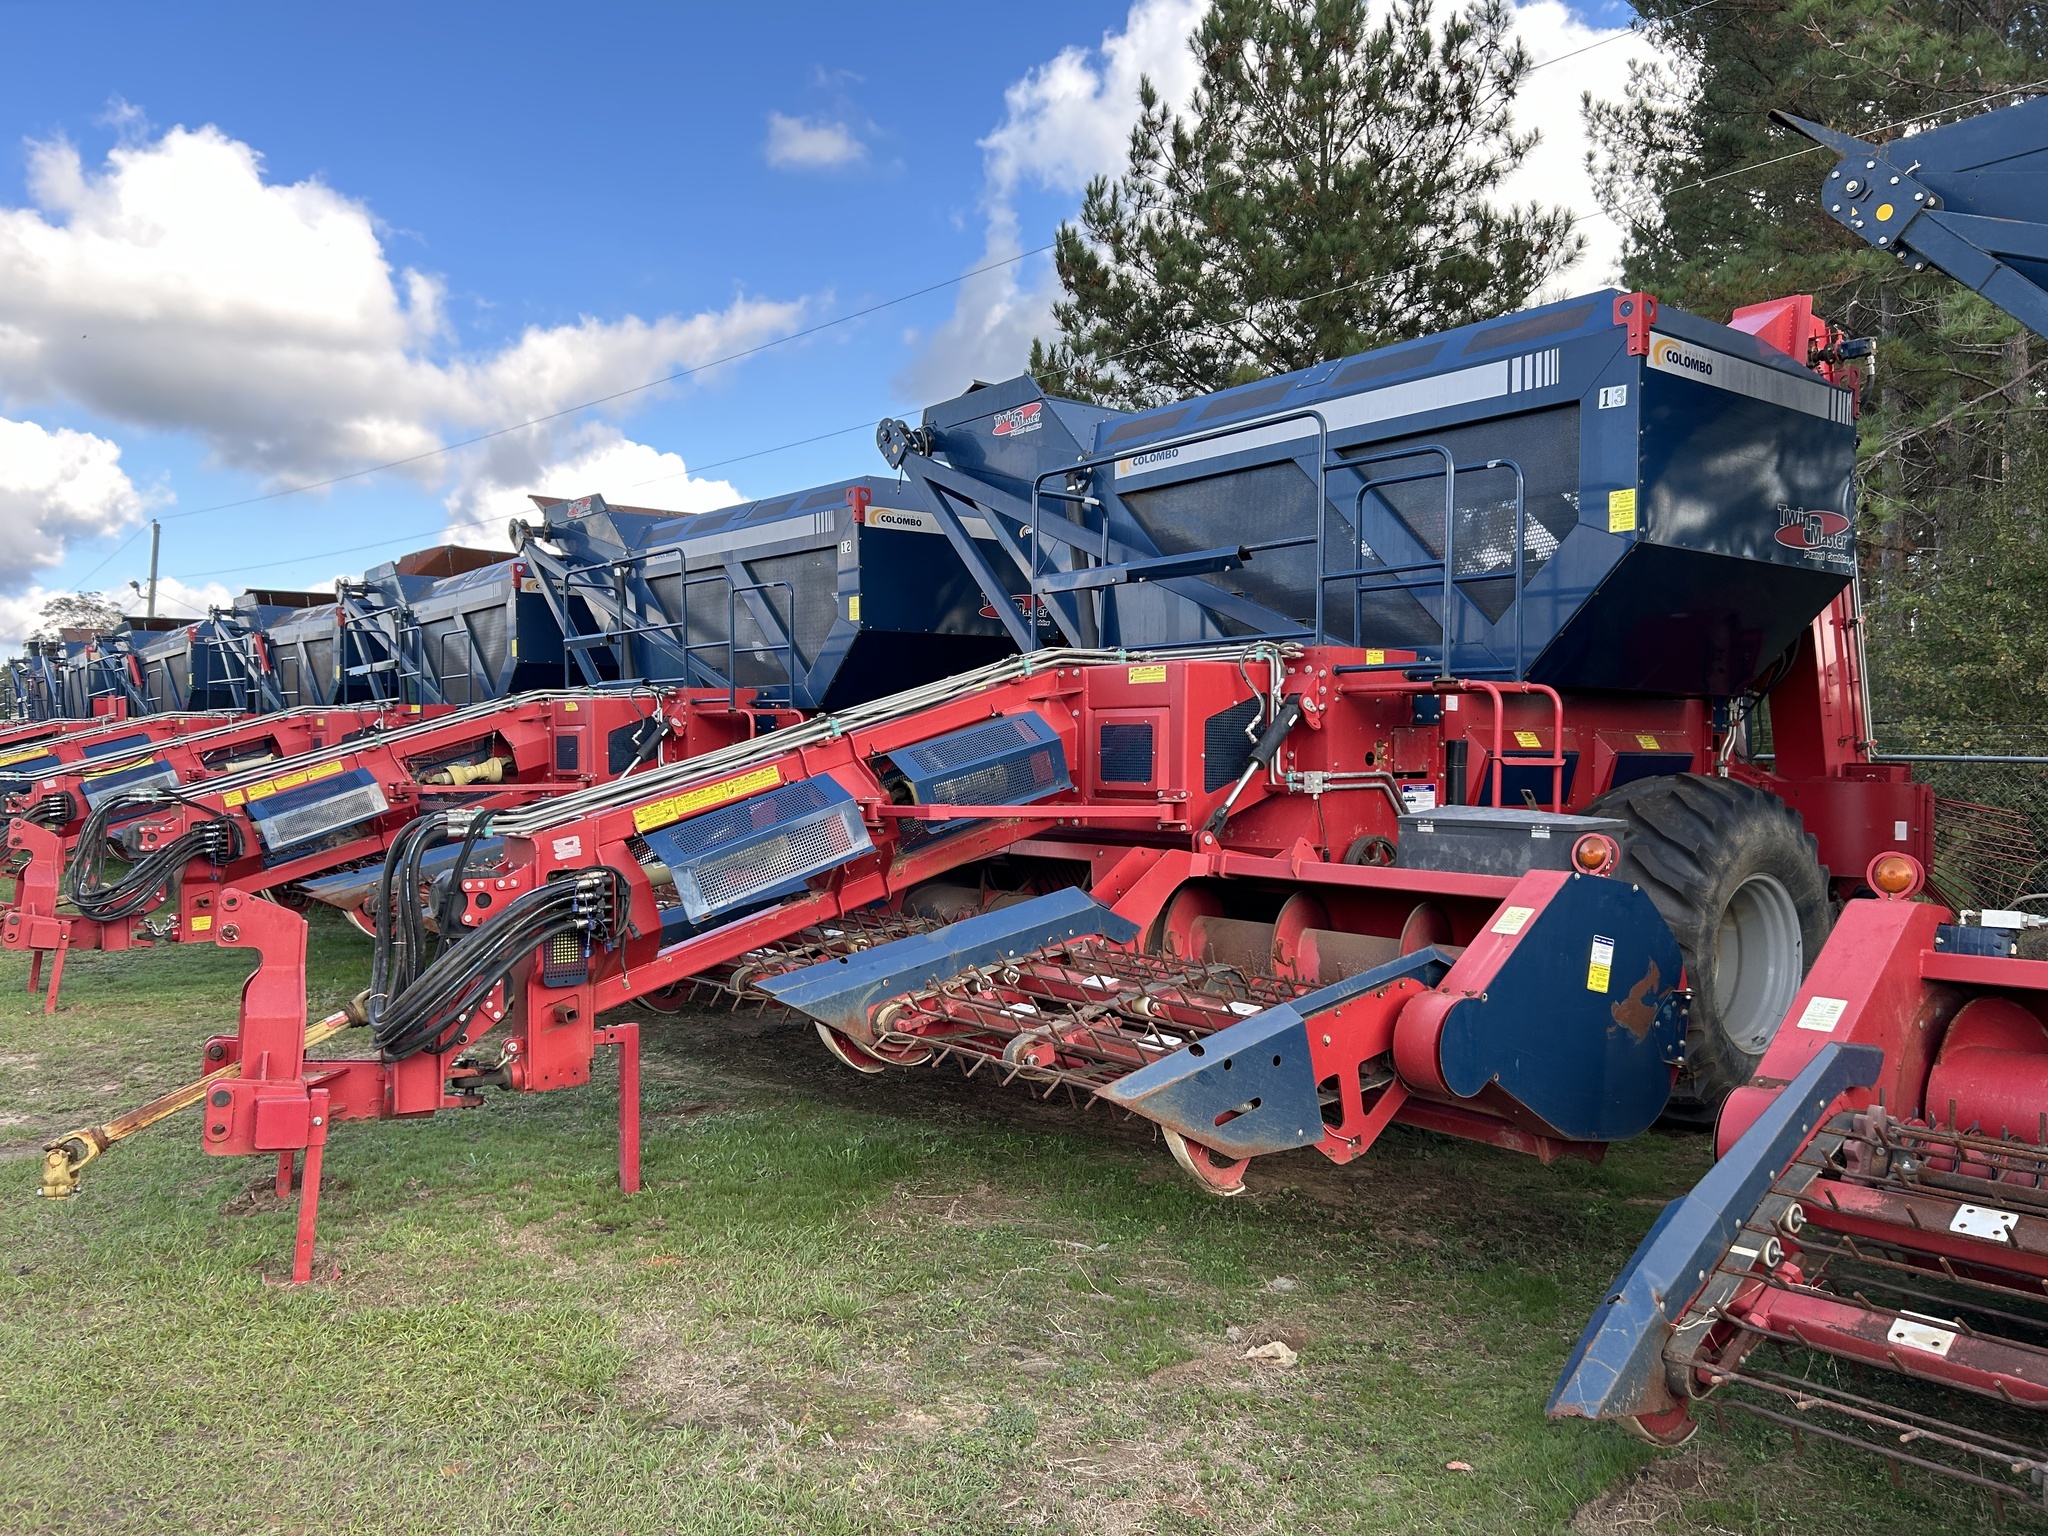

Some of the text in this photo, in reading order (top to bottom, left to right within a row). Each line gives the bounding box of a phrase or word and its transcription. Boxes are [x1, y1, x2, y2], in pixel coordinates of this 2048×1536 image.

[1666, 350, 1713, 375] COLOMBO
[1602, 387, 1625, 407] 13
[1133, 448, 1179, 466] COLOMBO
[881, 514, 922, 527] COLOMBO
[1777, 503, 1811, 529] Twin
[1810, 523, 1848, 549] Master
[842, 541, 851, 553] 12
